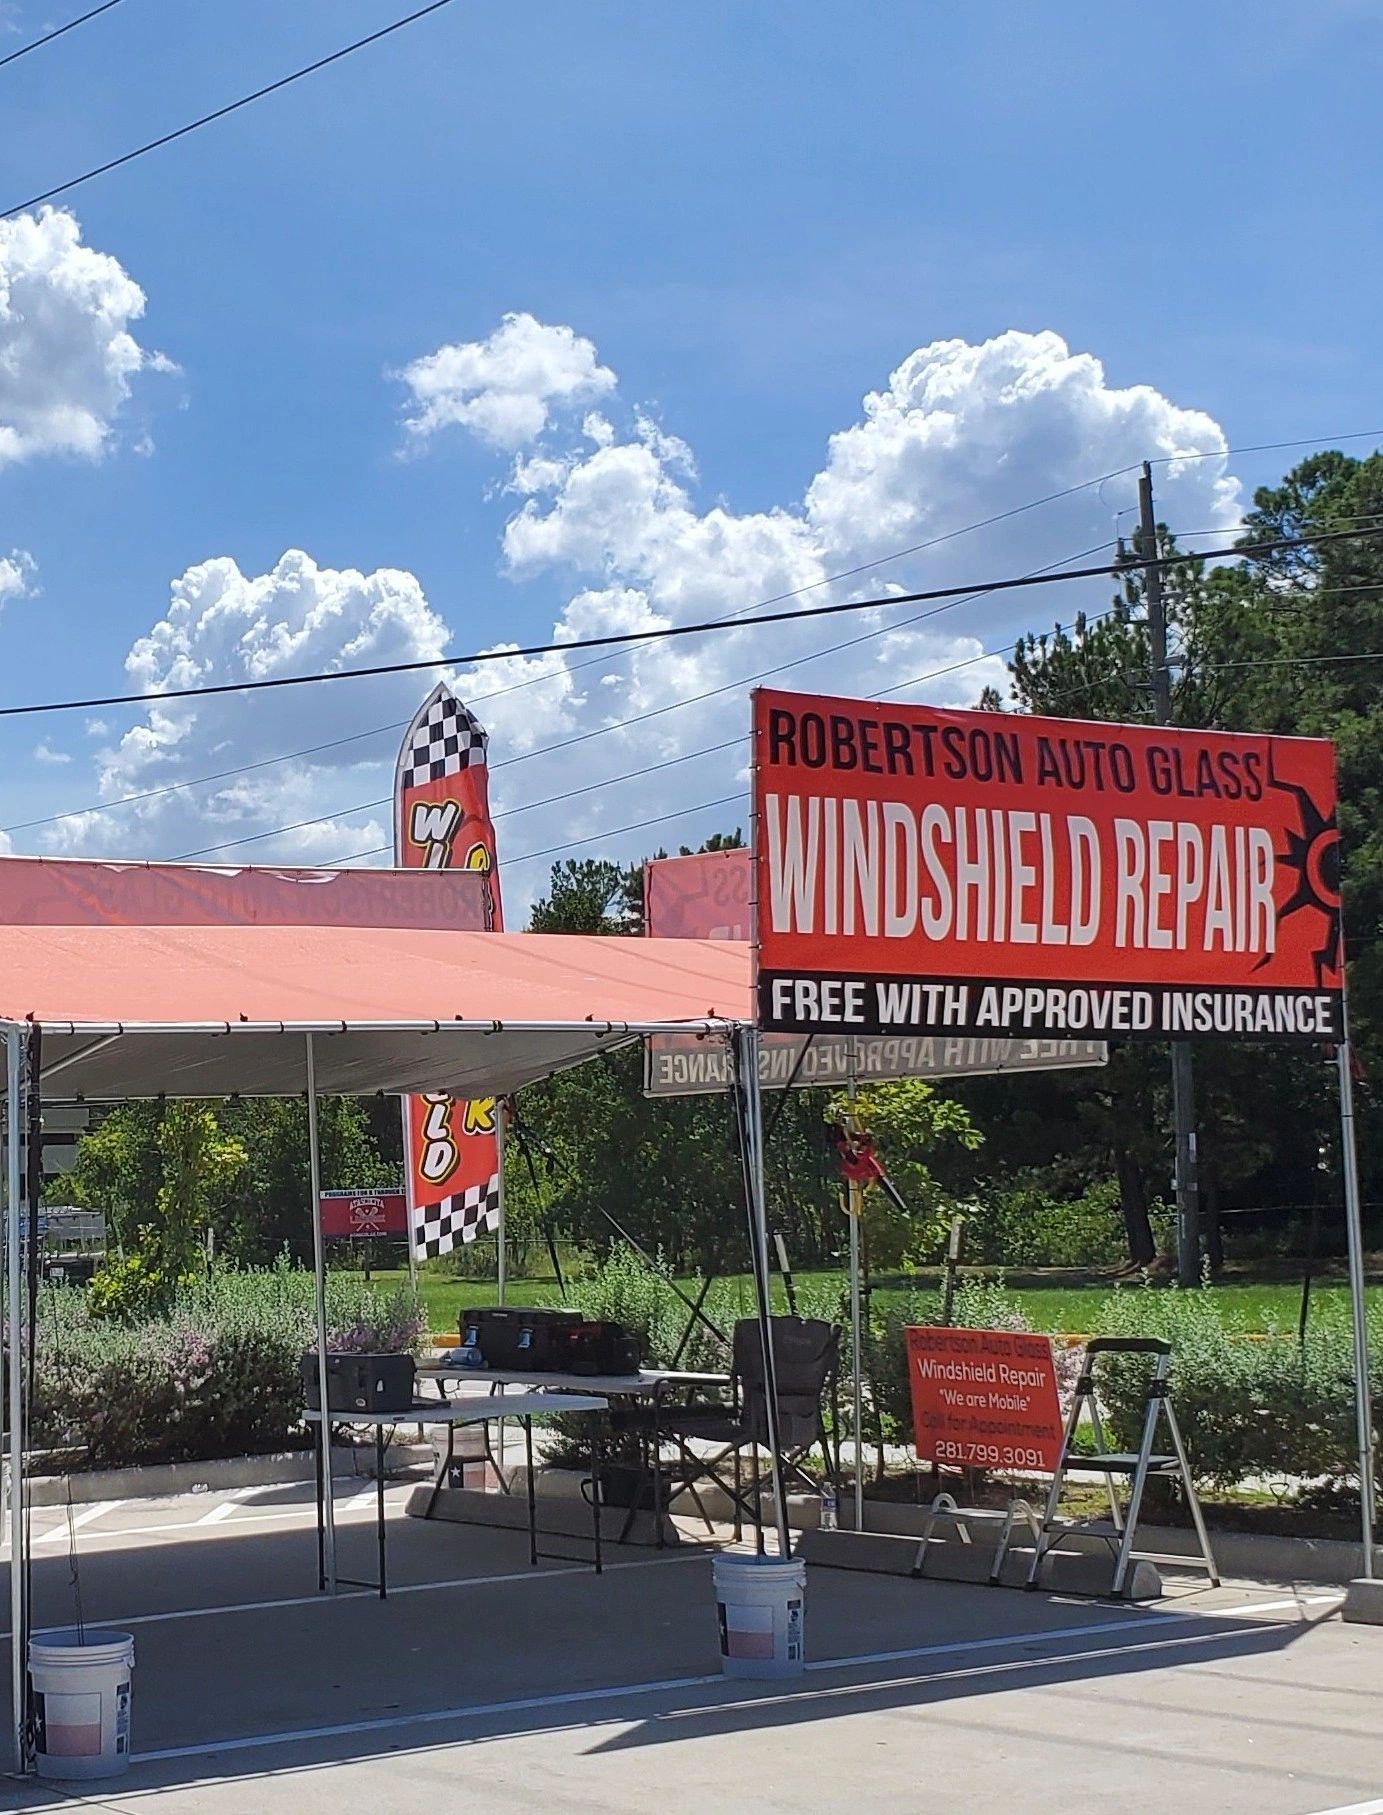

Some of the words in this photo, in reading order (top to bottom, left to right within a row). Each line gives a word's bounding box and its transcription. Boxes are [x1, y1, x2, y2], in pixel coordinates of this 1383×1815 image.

[769, 708, 1023, 785] ROBERTSON
[1037, 736, 1136, 794] AUTO
[1148, 745, 1264, 800] GLASS
[765, 793, 1102, 947] WINDSHIELD
[1114, 817, 1277, 955] REPAIR
[771, 978, 866, 1023] FREE
[876, 982, 966, 1027] WITH
[975, 987, 1153, 1032] APPROVED
[1161, 992, 1334, 1035] INSURANCE
[917, 1357, 996, 1383] Windshield
[999, 1363, 1046, 1390] Repair
[966, 1395, 987, 1408] are
[935, 1440, 1046, 1467] 281.799.3091
